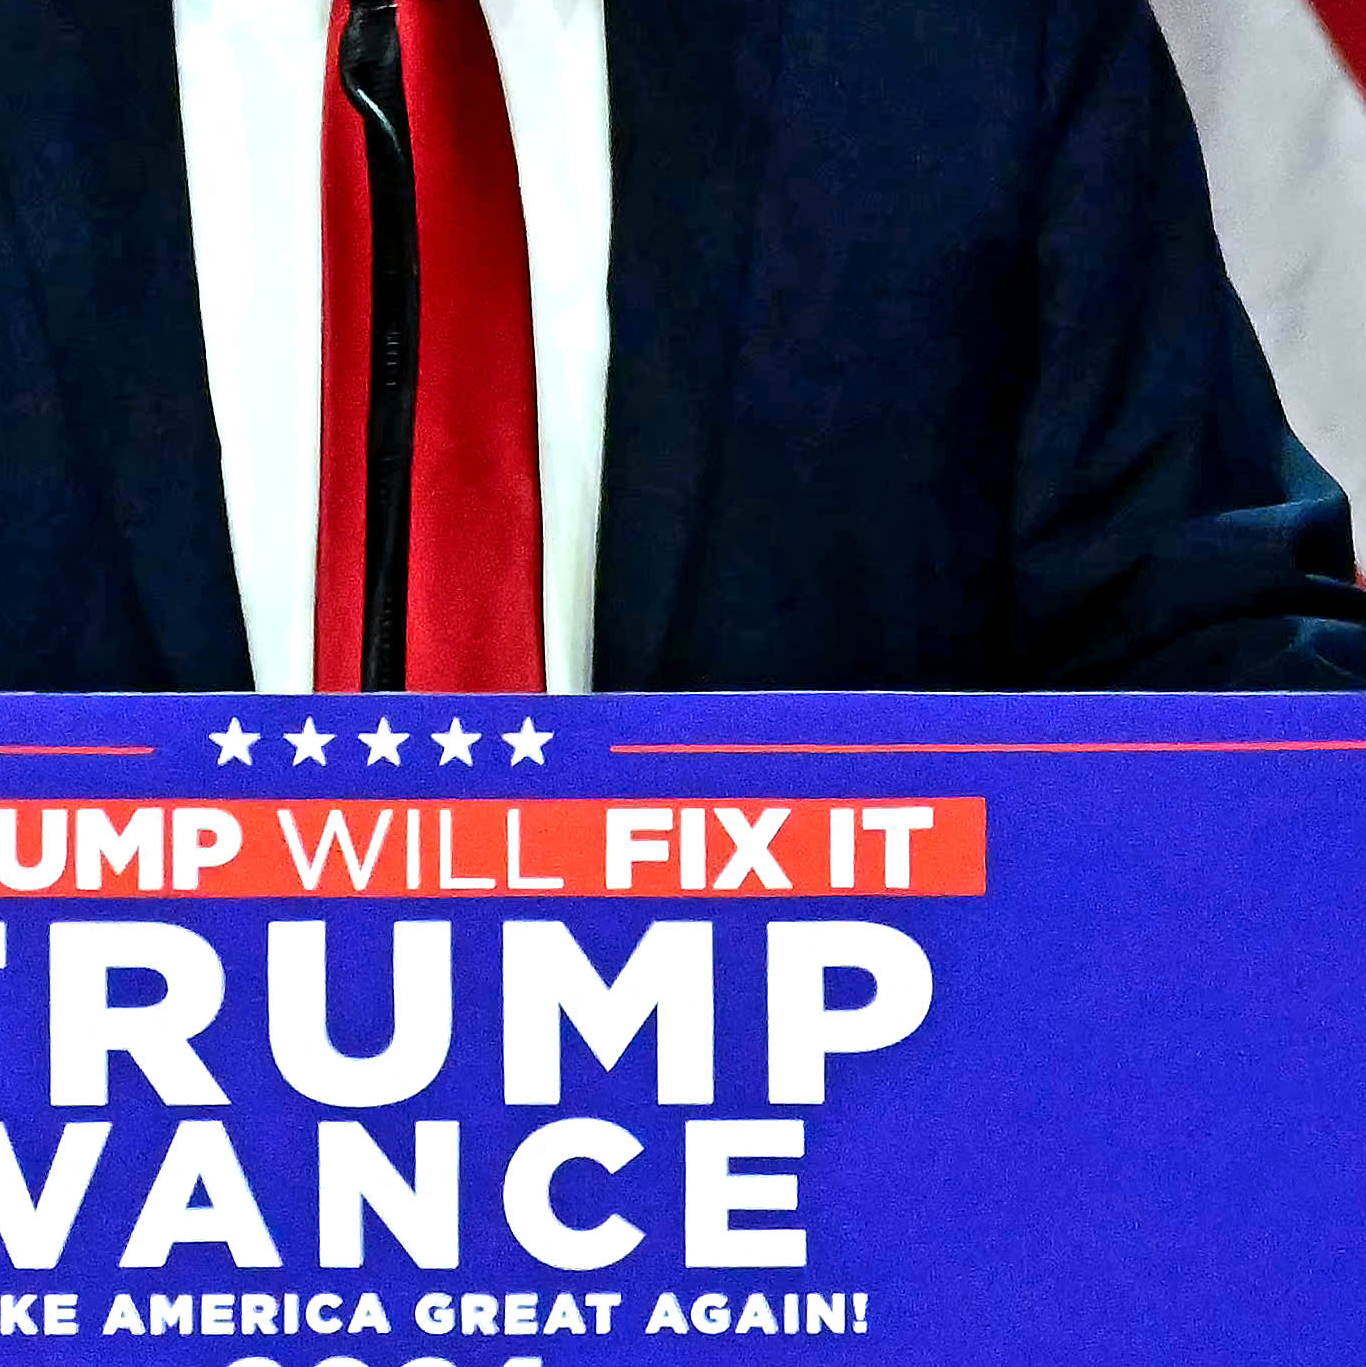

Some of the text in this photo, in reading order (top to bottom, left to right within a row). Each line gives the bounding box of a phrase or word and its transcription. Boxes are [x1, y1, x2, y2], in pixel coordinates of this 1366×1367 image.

[276, 808, 564, 891] WILL
[604, 807, 792, 891] FIX
[828, 806, 934, 890] IT
[102, 1292, 392, 1334] AMERICA
[413, 1292, 621, 1334] GREAT
[645, 1292, 869, 1334] AGAIN!
